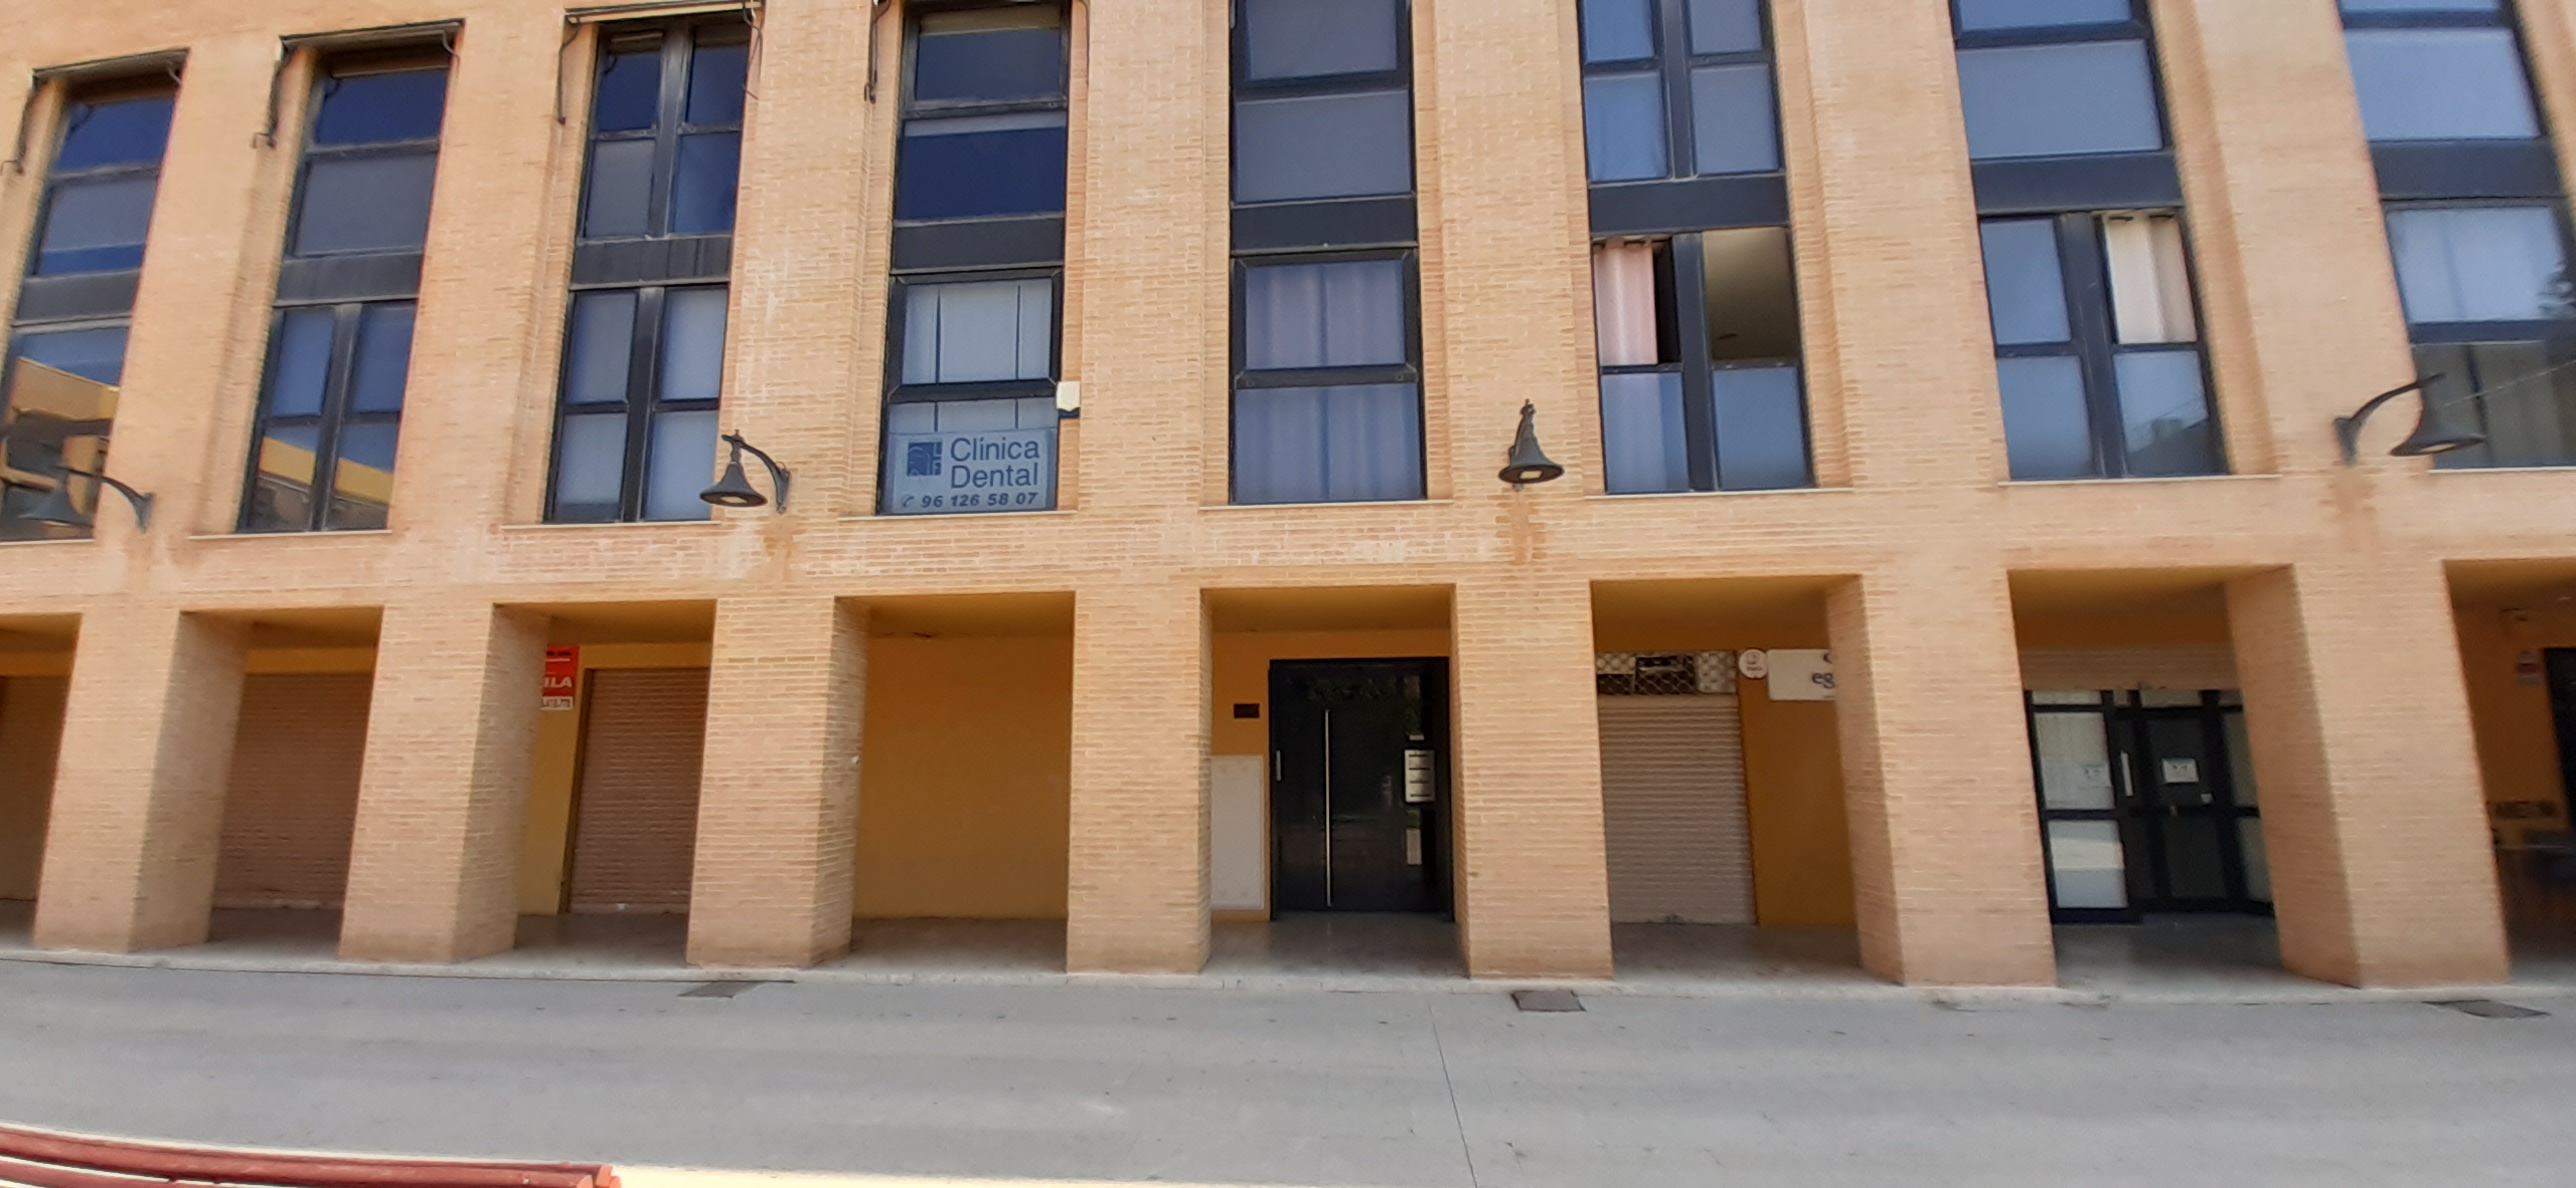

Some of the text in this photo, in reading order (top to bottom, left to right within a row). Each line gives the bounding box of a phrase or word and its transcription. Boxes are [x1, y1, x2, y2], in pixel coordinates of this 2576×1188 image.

[950, 437, 1040, 462] Clínica
[950, 462, 1039, 489] Dental
[921, 492, 1039, 508] 96 126 58 07
